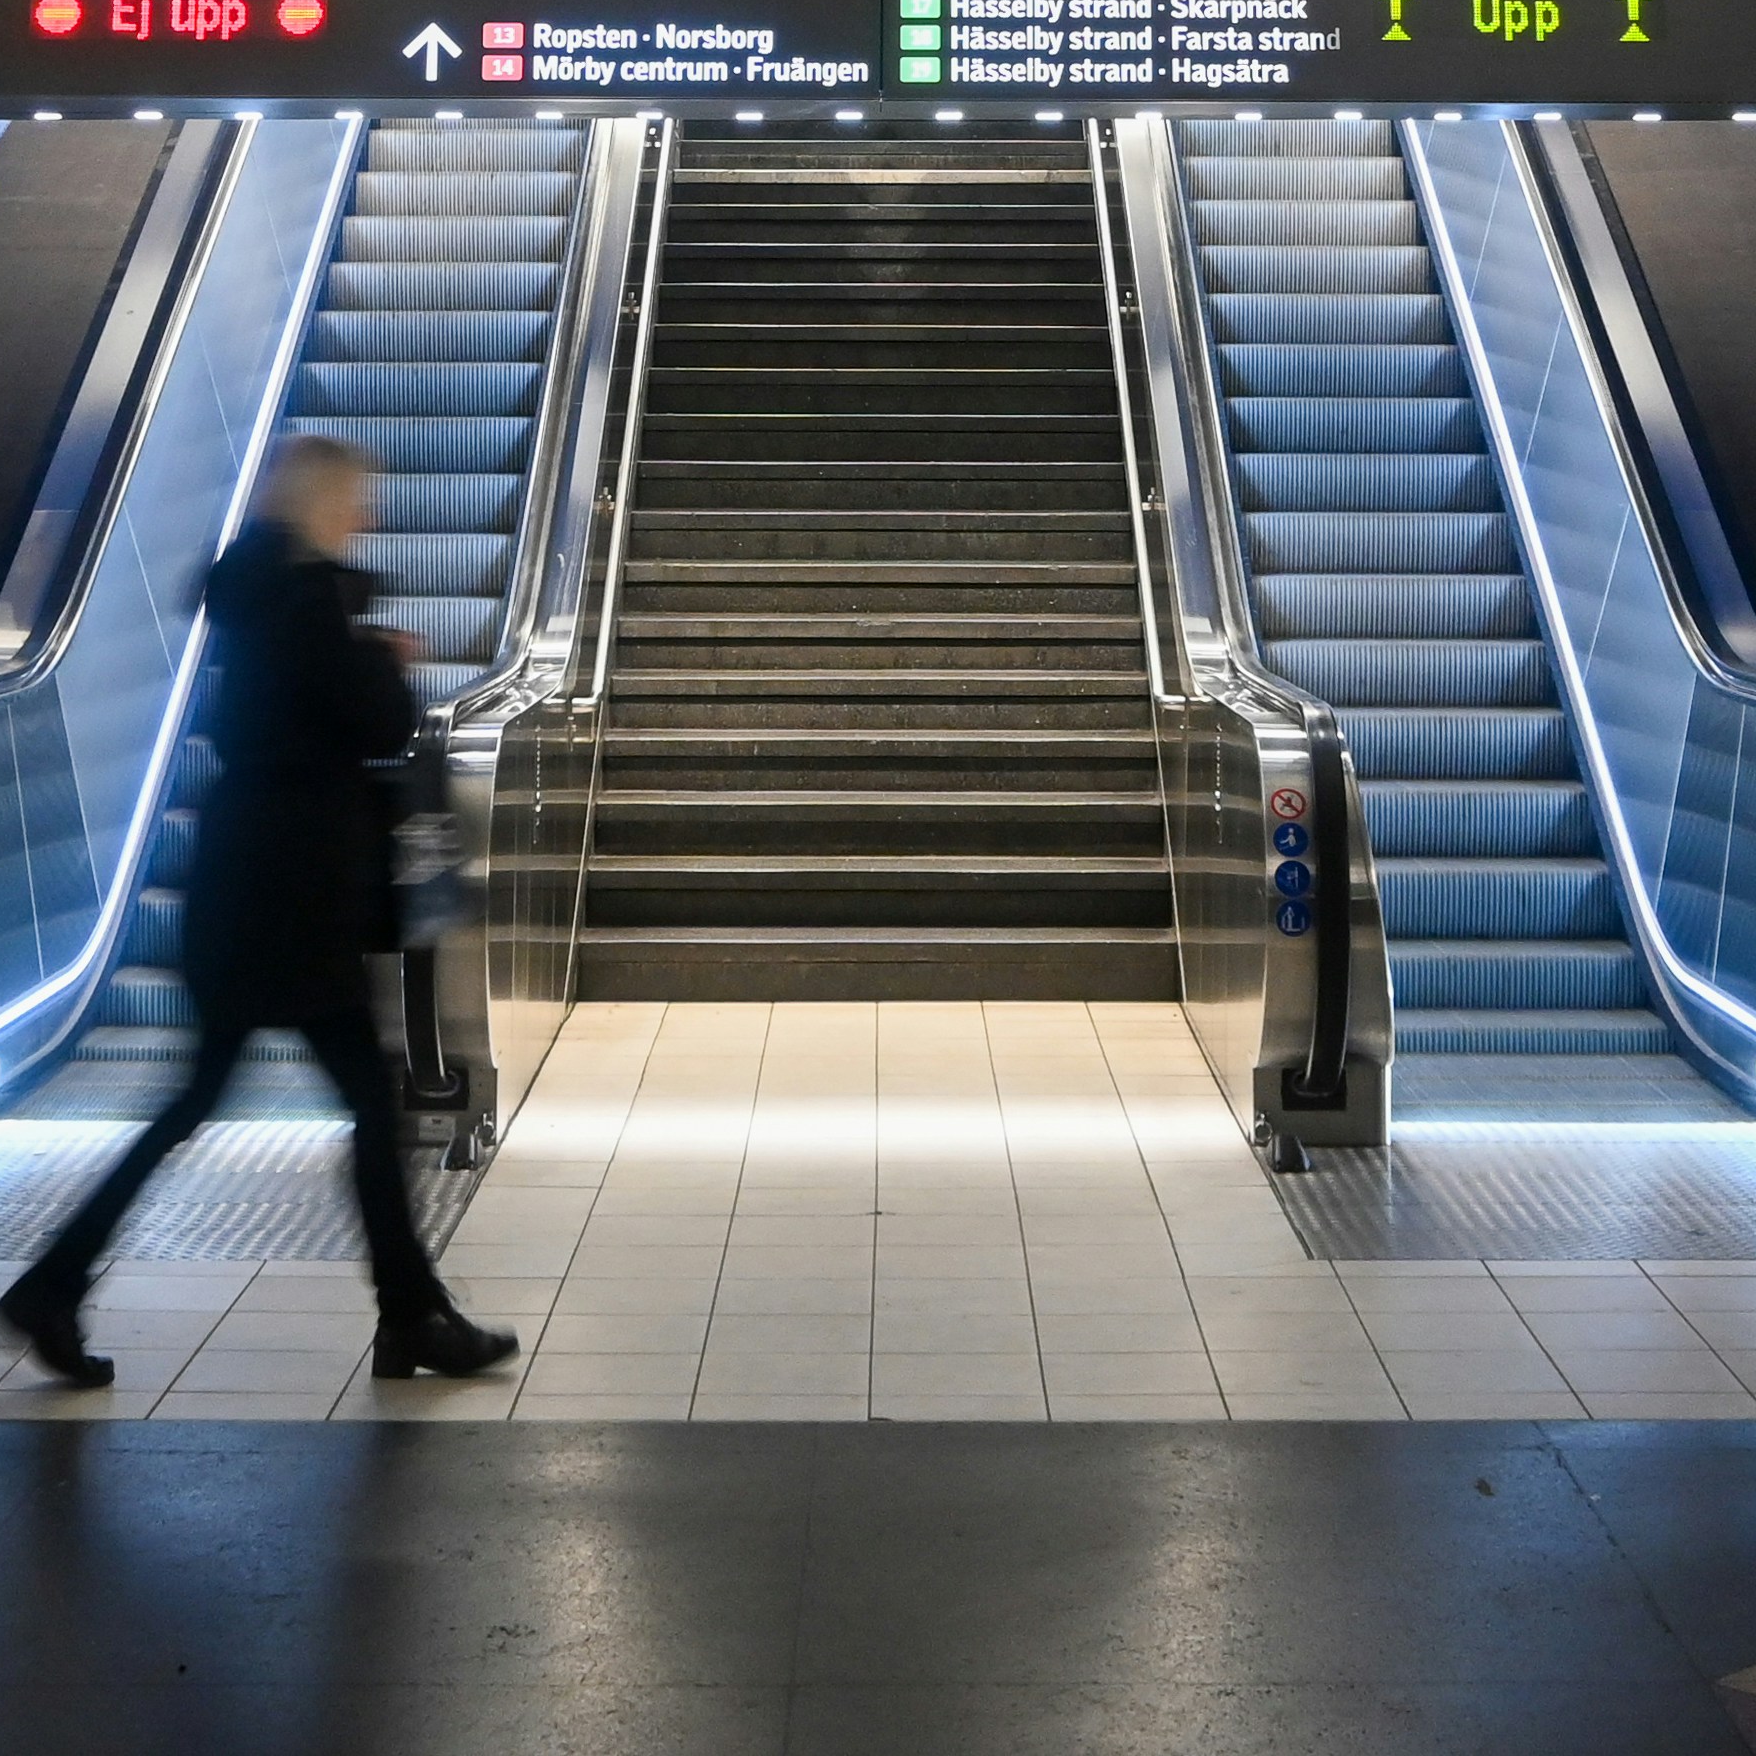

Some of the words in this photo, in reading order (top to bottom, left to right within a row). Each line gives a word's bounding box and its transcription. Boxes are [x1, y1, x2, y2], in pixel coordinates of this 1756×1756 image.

[493, 26, 515, 44] 13
[532, 23, 637, 53] Ropsten
[655, 23, 774, 54] Norsborg
[950, 25, 1064, 56] Hässelby
[1068, 26, 1152, 51] strand
[1171, 26, 1253, 51] Farsta
[1258, 27, 1340, 52] strand
[492, 59, 515, 76] 14
[532, 55, 616, 86] Mörby
[620, 58, 728, 82] centrum
[747, 56, 868, 86] Fruängen
[950, 57, 1064, 88] Hässelby
[1068, 58, 1153, 83] strand
[1171, 57, 1290, 88] Hagsätra
